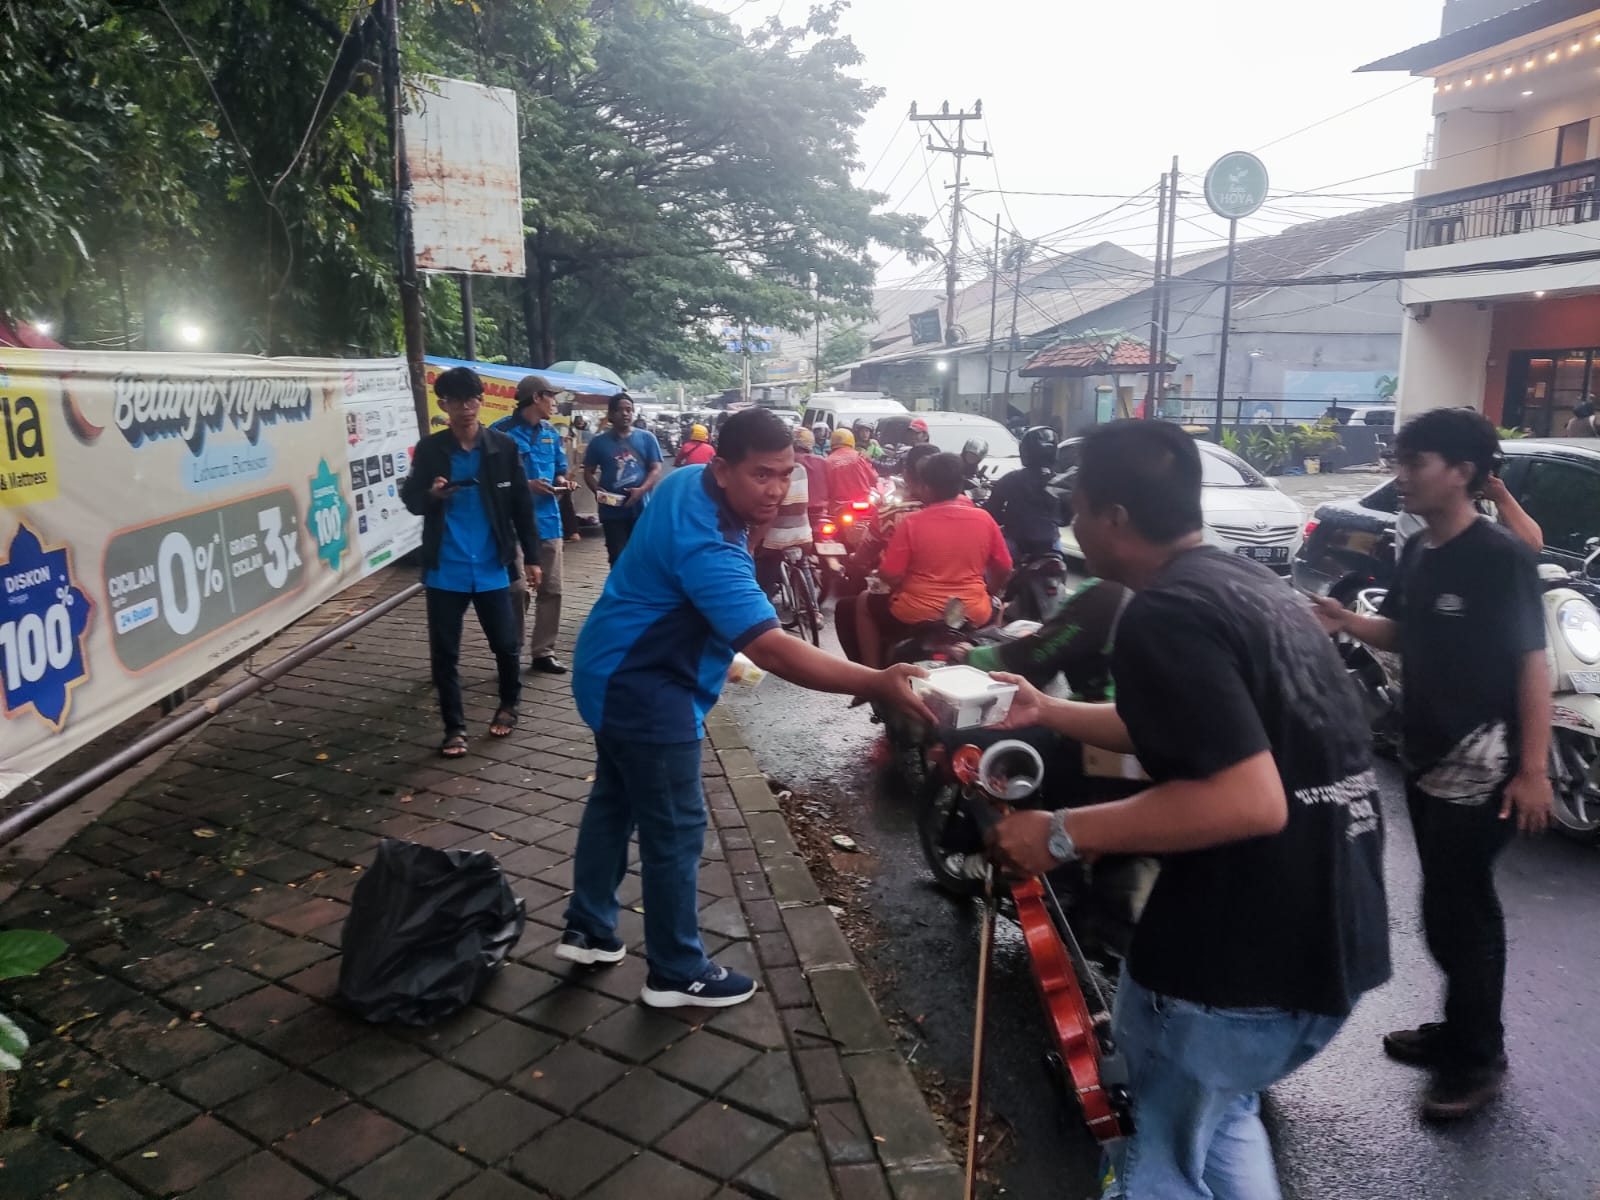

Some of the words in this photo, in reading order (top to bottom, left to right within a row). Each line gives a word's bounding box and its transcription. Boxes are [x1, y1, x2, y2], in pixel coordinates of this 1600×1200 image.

[1220, 192, 1255, 206] HOYA
[5, 565, 52, 594] DISKON
[108, 564, 155, 598] CICILAN
